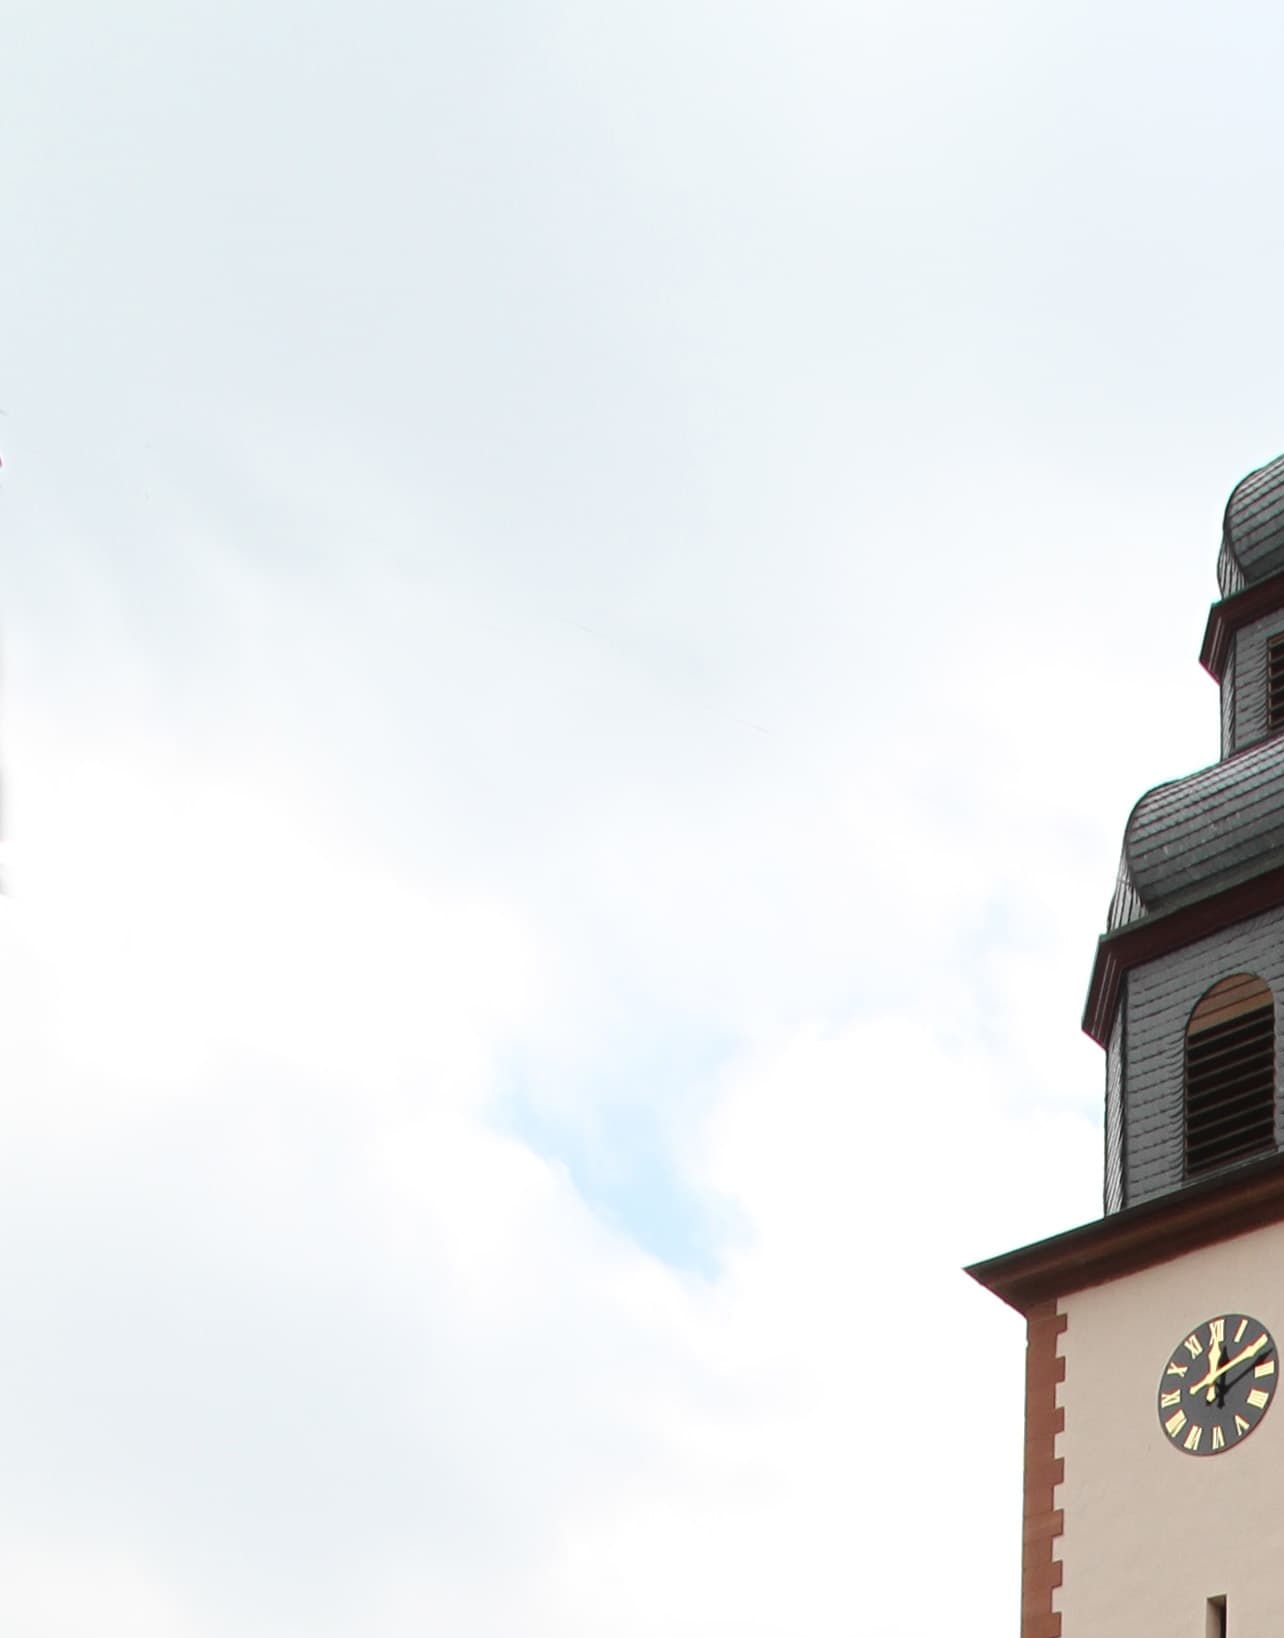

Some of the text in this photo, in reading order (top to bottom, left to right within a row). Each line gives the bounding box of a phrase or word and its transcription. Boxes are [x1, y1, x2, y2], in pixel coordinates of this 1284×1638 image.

[1234, 1319, 1248, 1343] I
[1184, 1334, 1203, 1360] XI
[1166, 1361, 1188, 1378] X
[1254, 1360, 1275, 1379] III
[1161, 1389, 1181, 1408] IX
[1234, 1414, 1250, 1436] V
